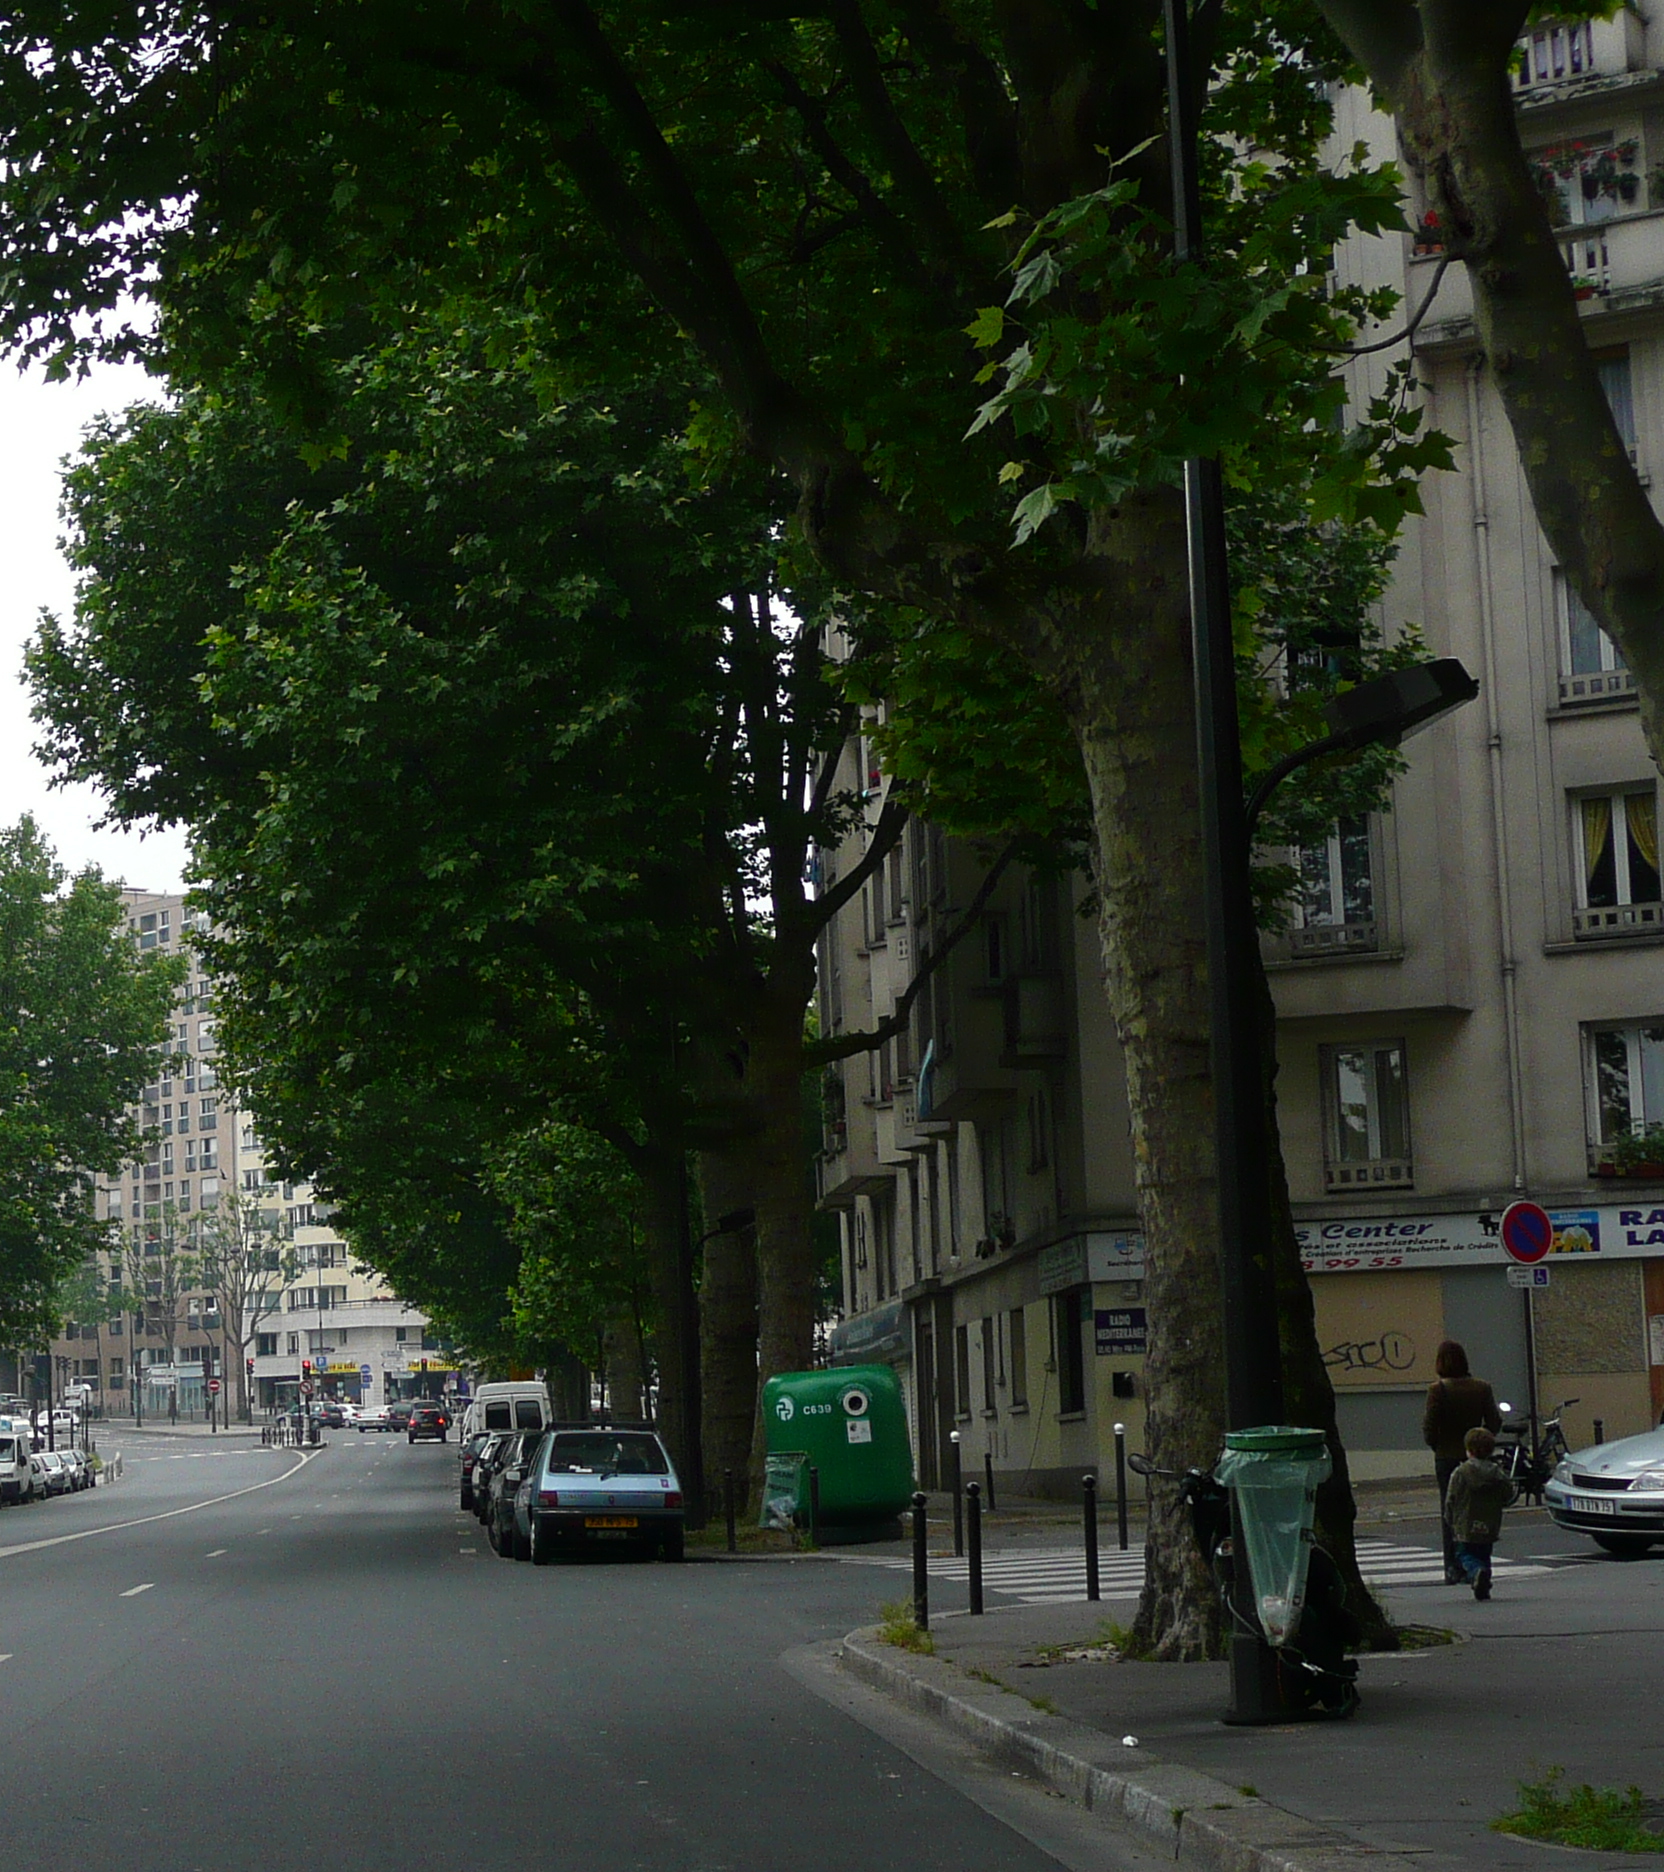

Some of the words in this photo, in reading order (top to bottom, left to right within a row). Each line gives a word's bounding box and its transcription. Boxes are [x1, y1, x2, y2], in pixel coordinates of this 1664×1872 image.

[1322, 1223, 1433, 1240] Center
[1368, 1256, 1404, 1267] 55
[803, 1404, 832, 1415] C639
